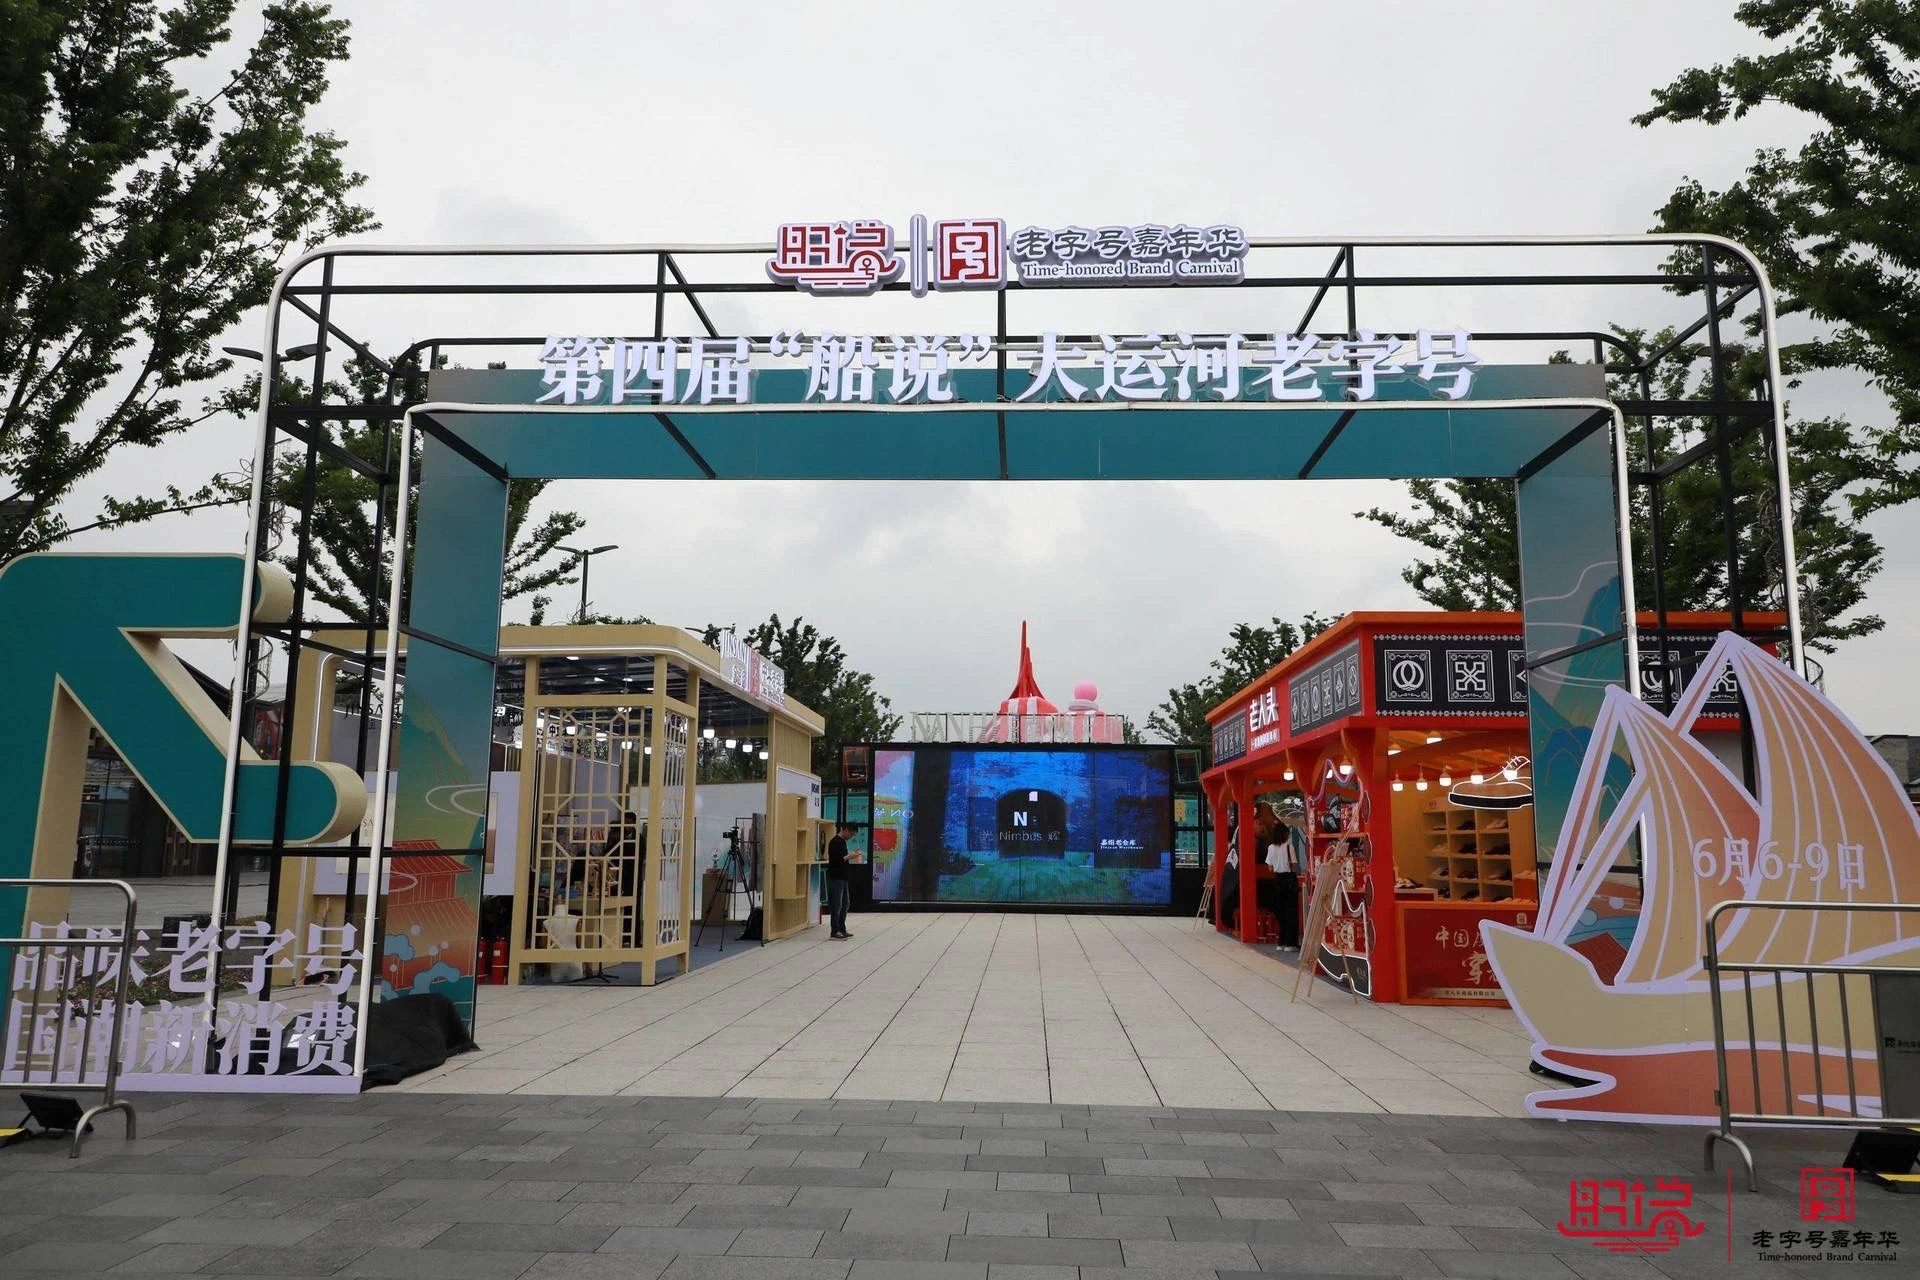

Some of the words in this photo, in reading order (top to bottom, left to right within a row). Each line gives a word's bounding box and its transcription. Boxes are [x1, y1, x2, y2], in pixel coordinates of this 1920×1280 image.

[1016, 227, 1243, 257] 老字号嘉年华
[1024, 262, 1123, 277] Time-honored
[1130, 262, 1171, 274] Brand
[1178, 260, 1239, 273] Carnival
[1692, 837, 1867, 890] 6月6-9日
[12, 920, 364, 995] 品味老字号
